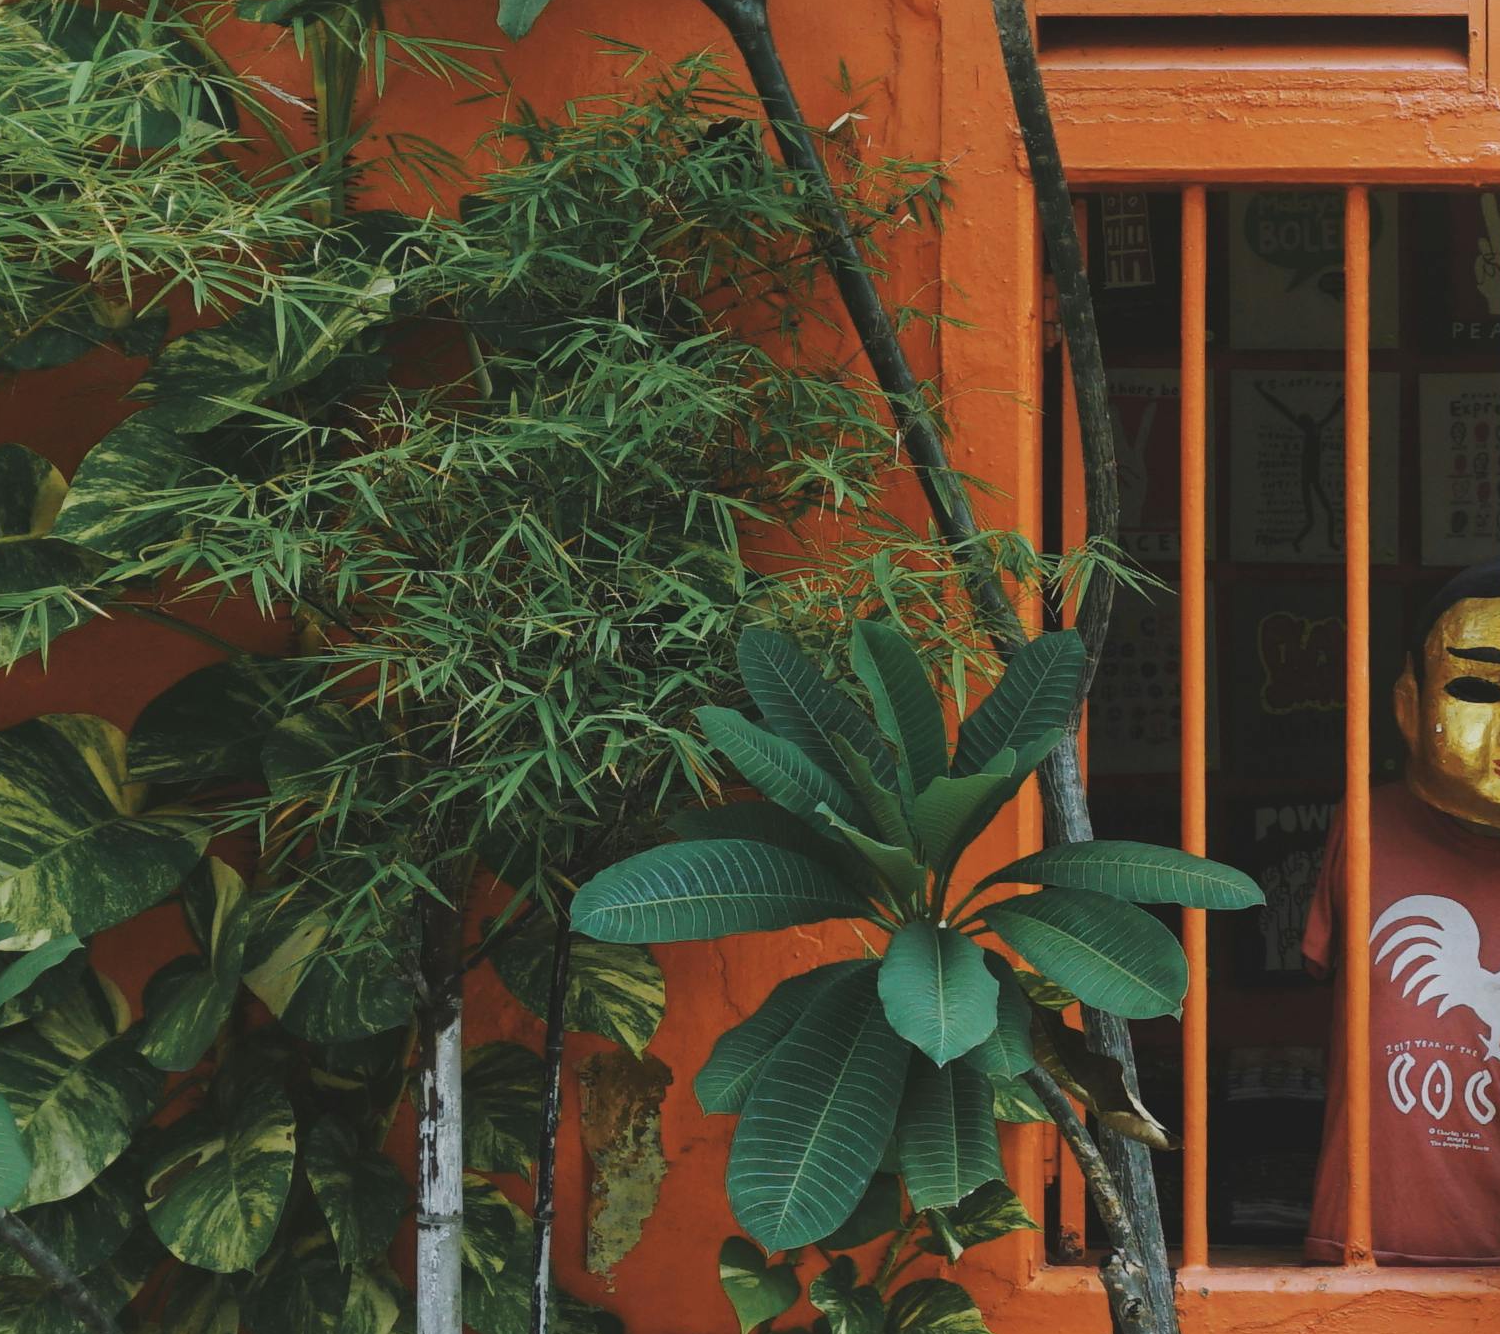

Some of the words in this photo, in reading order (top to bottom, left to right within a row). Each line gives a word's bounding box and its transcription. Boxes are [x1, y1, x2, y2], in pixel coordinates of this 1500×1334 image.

[1260, 219, 1343, 254] BOLE
[1386, 1040, 1411, 1056] 2017
[1414, 1039, 1441, 1049] YEAR
